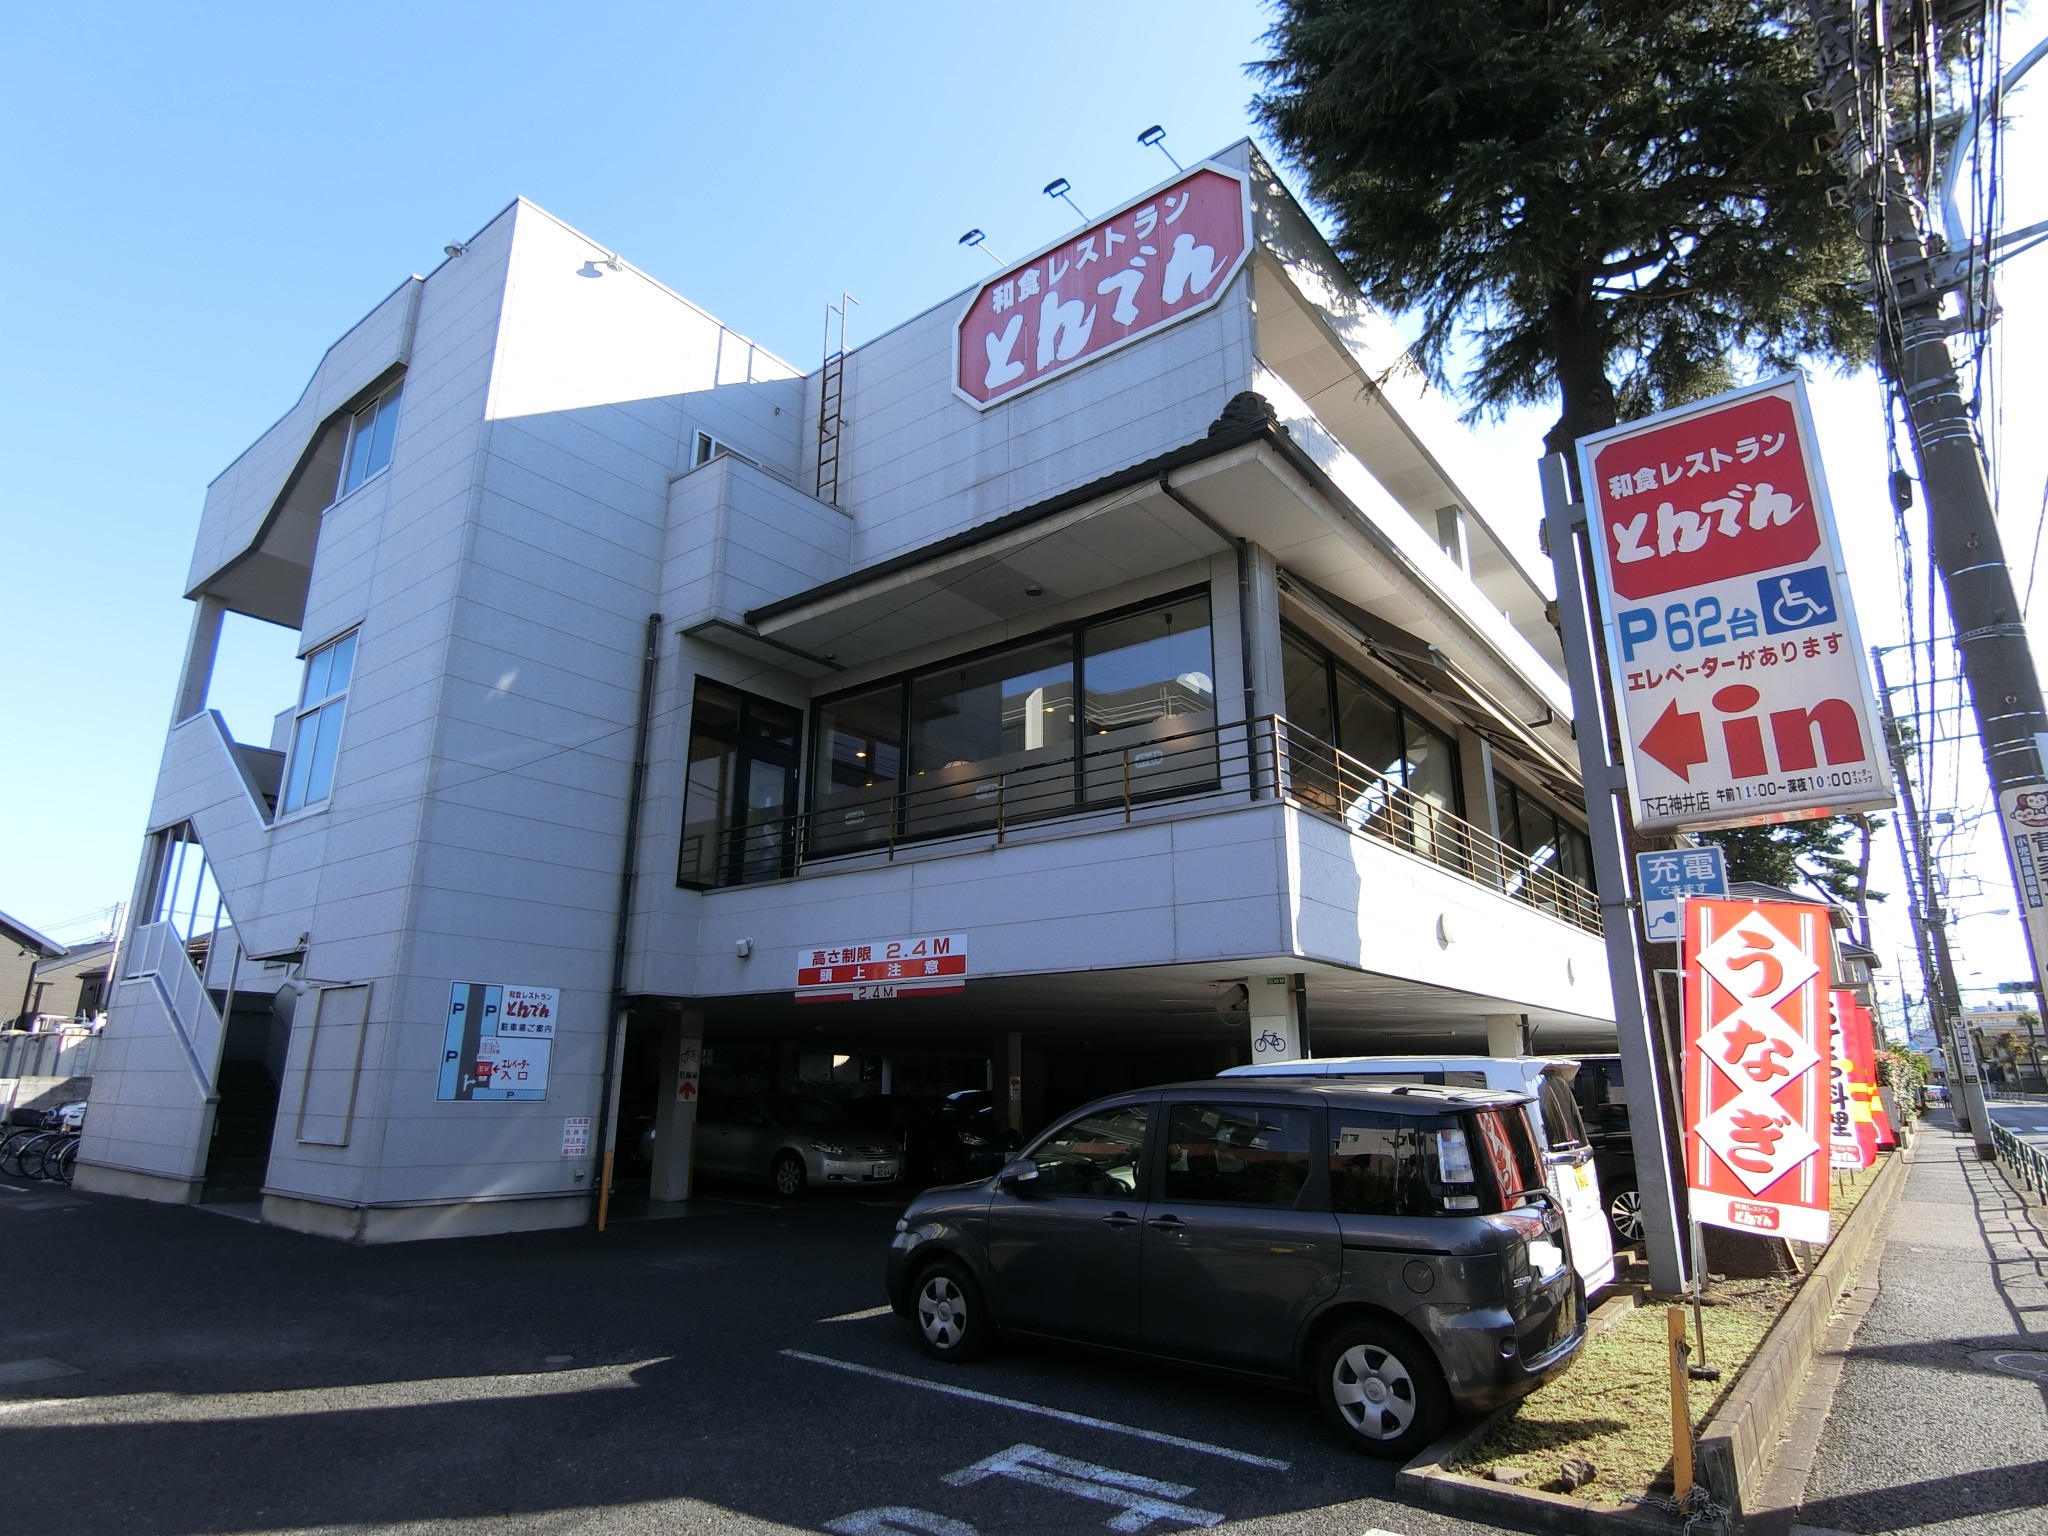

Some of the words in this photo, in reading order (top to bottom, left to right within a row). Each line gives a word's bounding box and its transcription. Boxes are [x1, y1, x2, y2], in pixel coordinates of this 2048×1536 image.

[992, 191, 1190, 314] 和食レストラン
[984, 233, 1229, 389] とんでん
[1608, 432, 1785, 499] 和食レストラン
[1612, 483, 1805, 564] とんでん
[1627, 632, 1843, 691] エレベーターがあります
[1711, 684, 1866, 779] in
[1642, 790, 1710, 817] 下石神井店
[1647, 853, 1716, 884] 充電
[1658, 882, 1708, 896] できます
[812, 946, 871, 966] 高さ制限
[820, 960, 939, 982] 頭上注意
[509, 991, 552, 1000] 和食レストラン
[858, 986, 894, 1000] 2.4M
[452, 1003, 465, 1015] P
[485, 1005, 497, 1016] P
[506, 1000, 550, 1018] とんでん
[500, 1022, 552, 1033] 駐車場ご案内
[445, 1051, 458, 1062] P
[1722, 930, 1794, 1174] うなぎ
[502, 1060, 530, 1069] エレベーター
[501, 1071, 528, 1080] 入口
[506, 1091, 515, 1099] P
